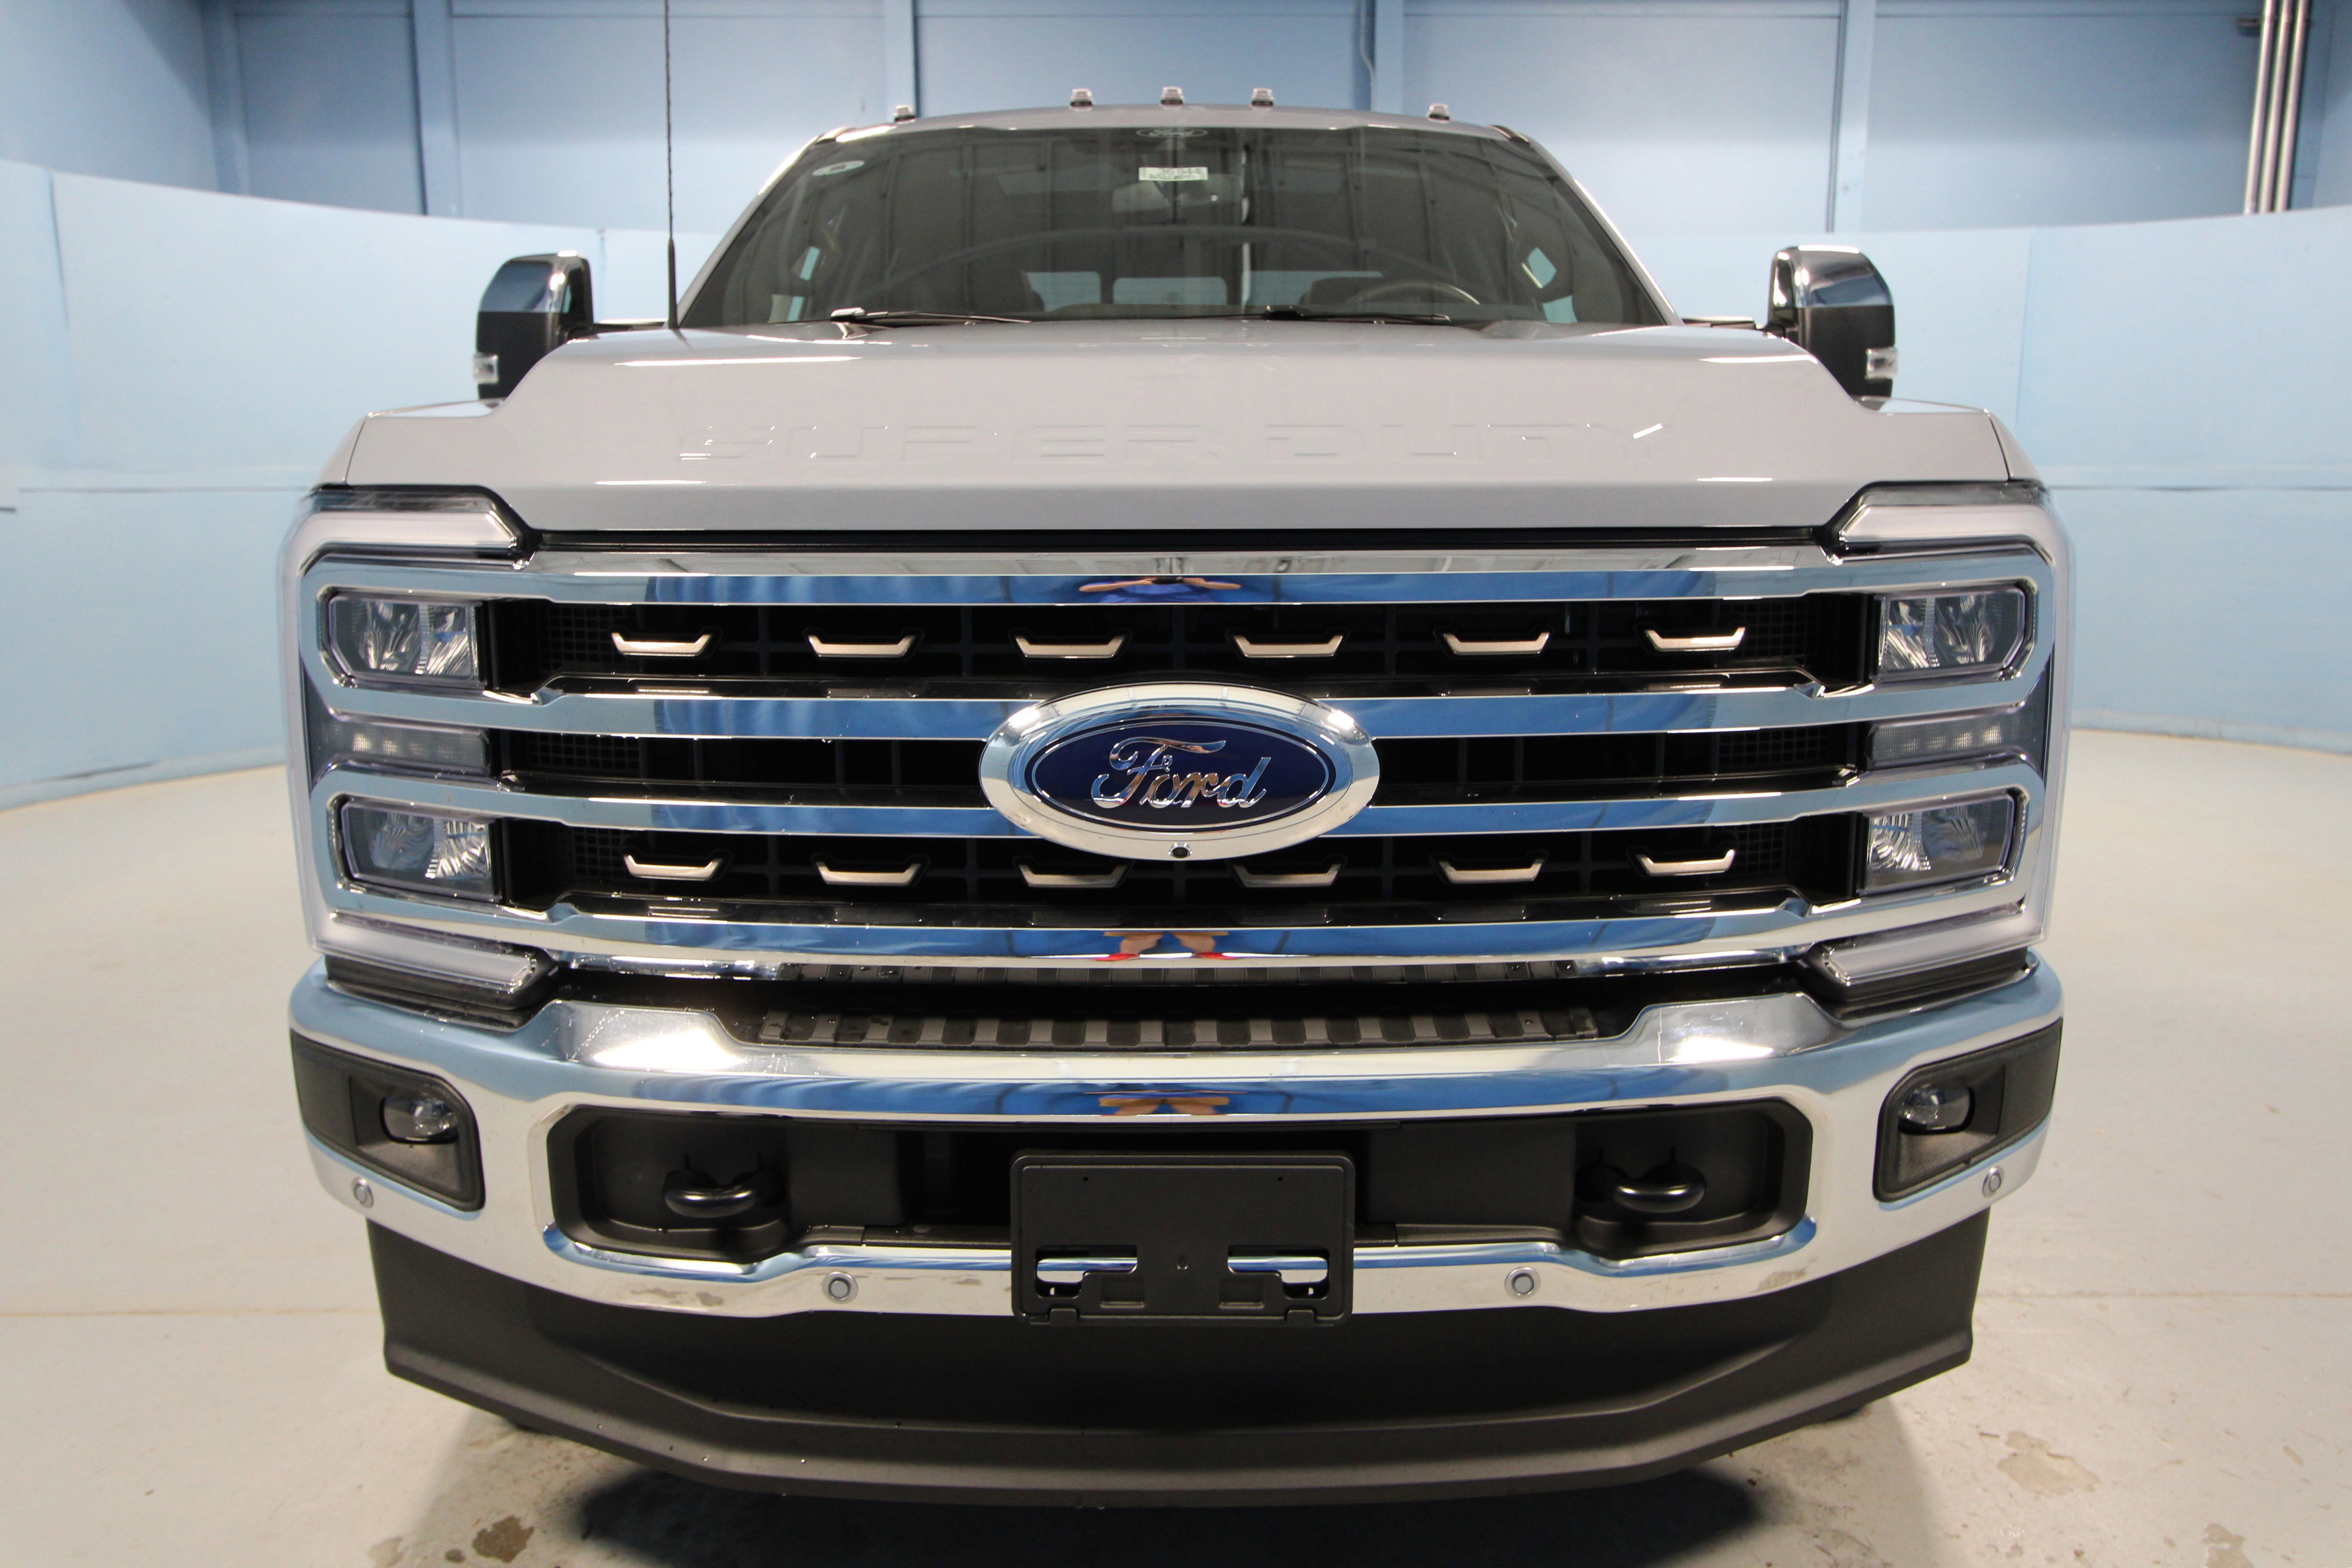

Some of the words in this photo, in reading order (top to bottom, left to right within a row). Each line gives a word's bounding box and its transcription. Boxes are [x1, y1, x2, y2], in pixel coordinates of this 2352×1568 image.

[675, 423, 1220, 463] SUPER
[1263, 423, 1677, 463] DUTY
[1091, 737, 1272, 808] Ford
